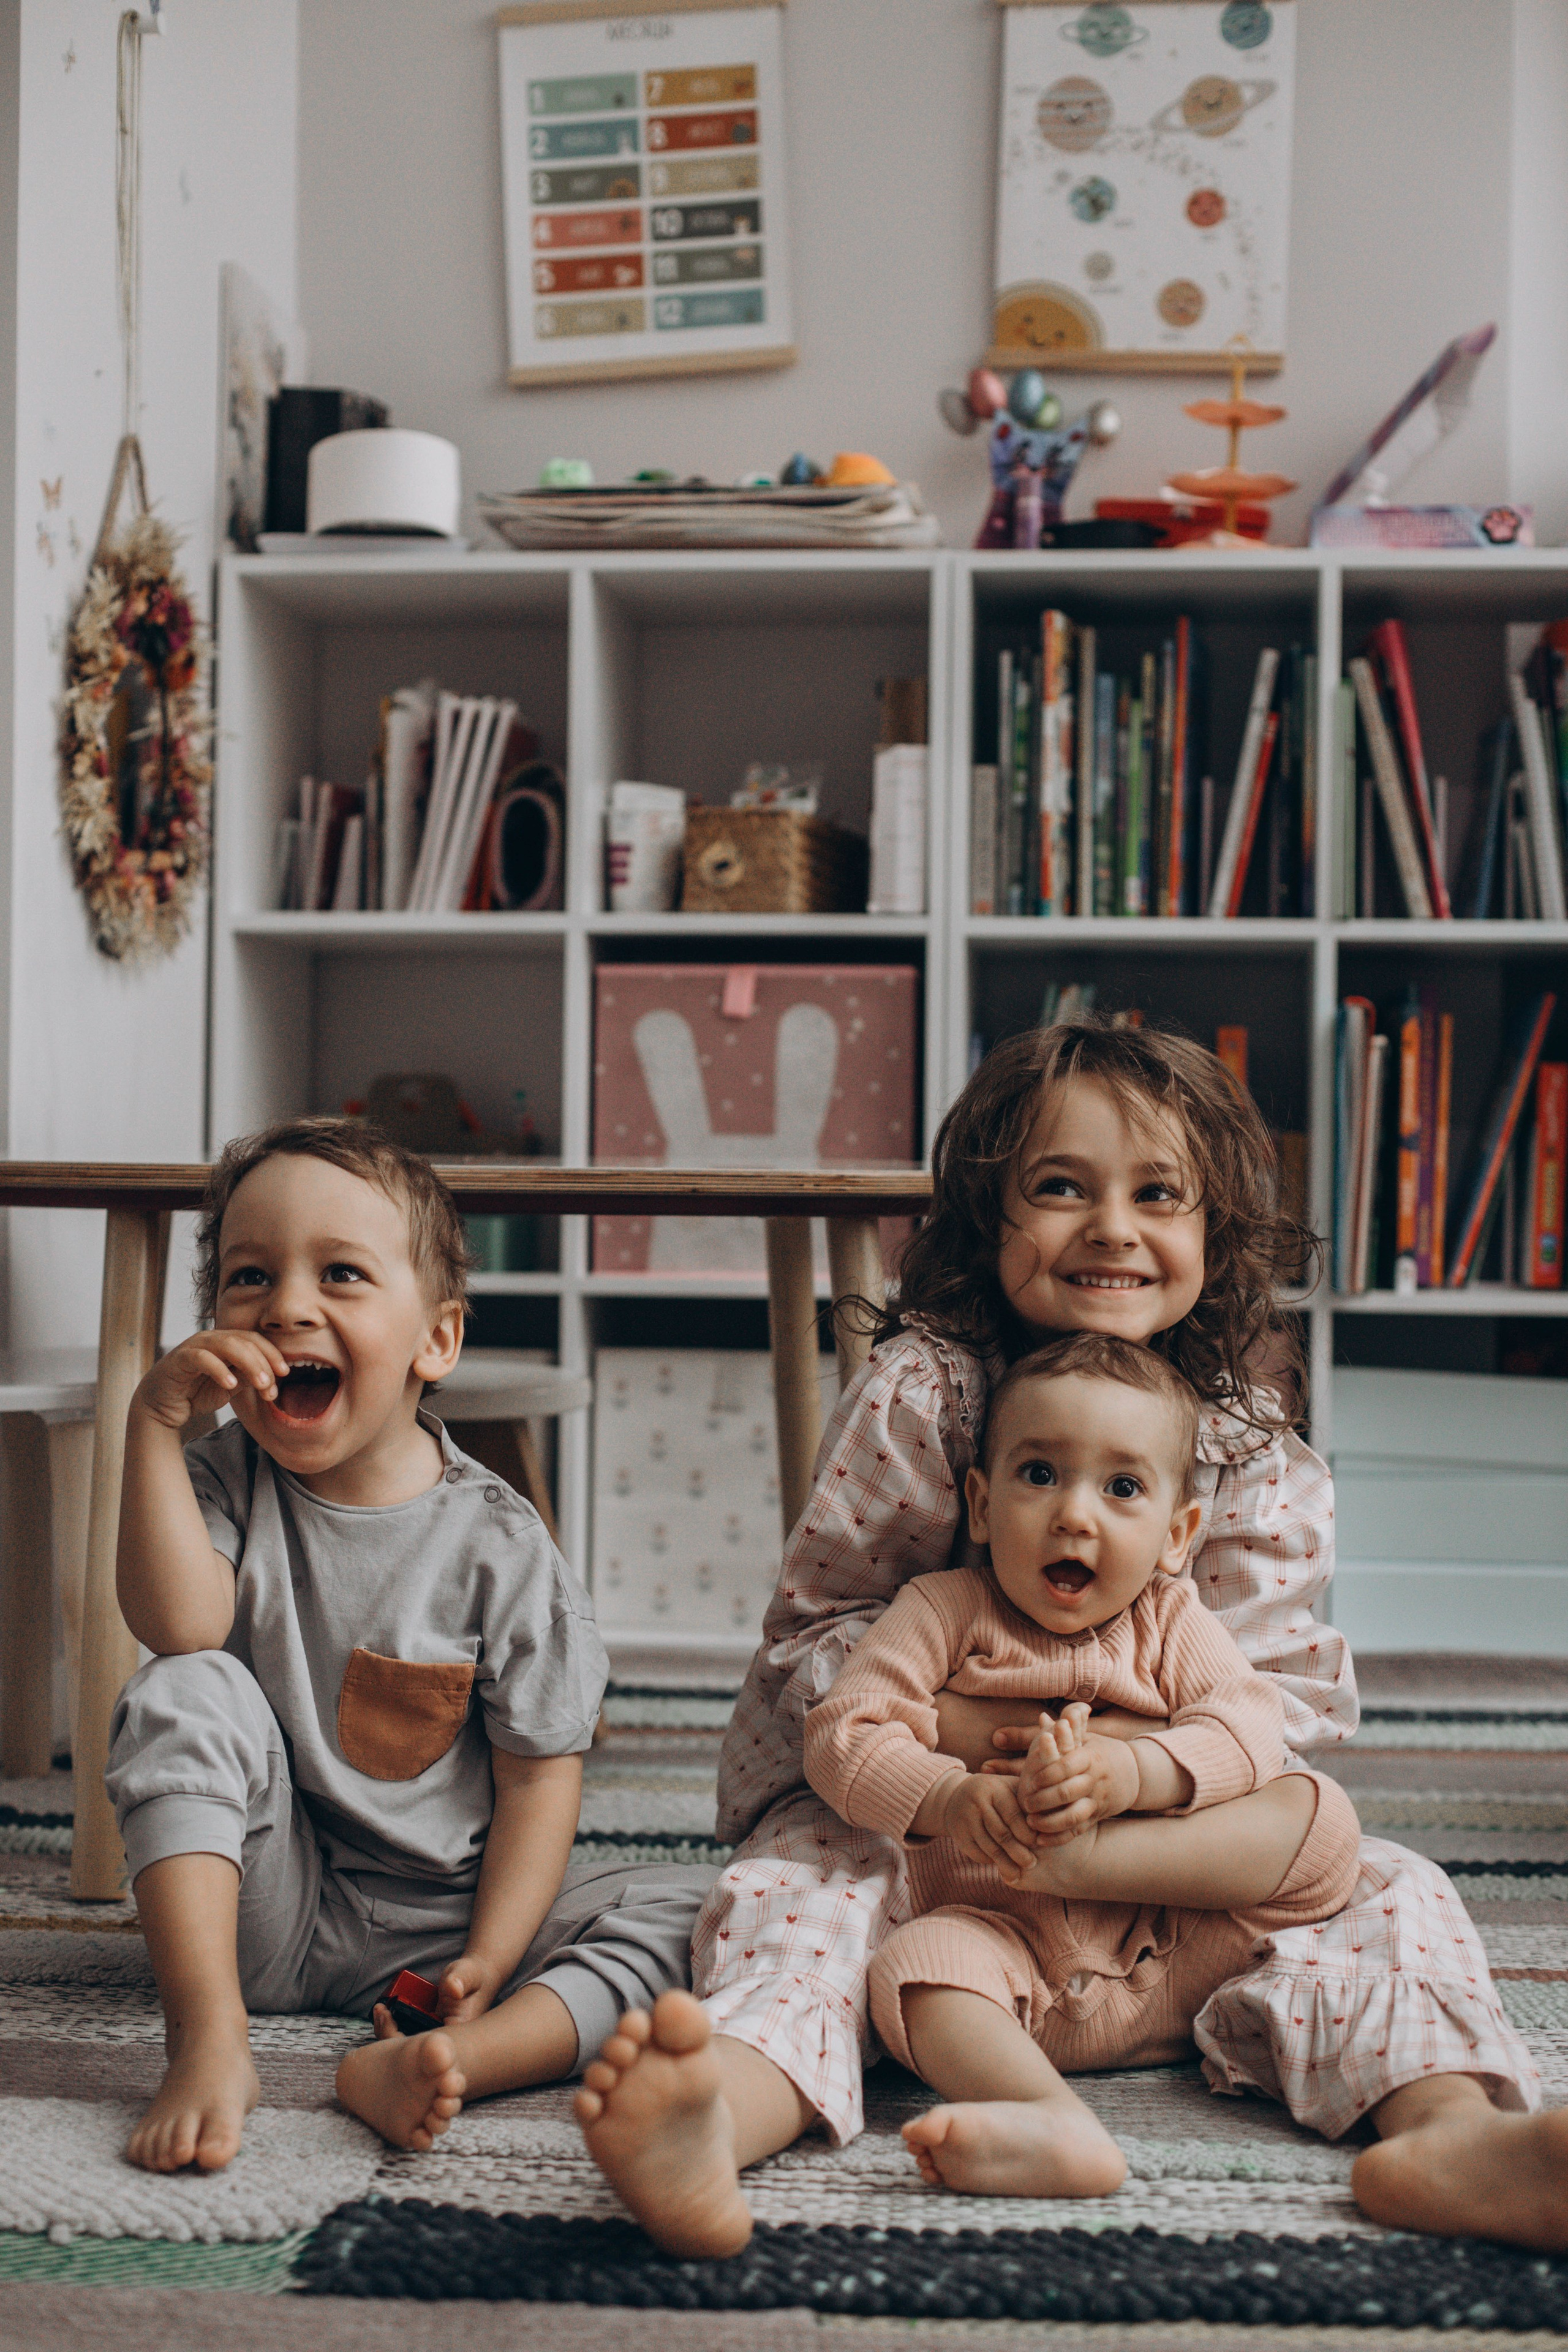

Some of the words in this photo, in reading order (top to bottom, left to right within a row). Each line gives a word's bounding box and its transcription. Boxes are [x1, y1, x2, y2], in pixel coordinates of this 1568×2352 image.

[648, 75, 665, 102] 7
[531, 130, 548, 156] 2
[654, 209, 684, 236] 10
